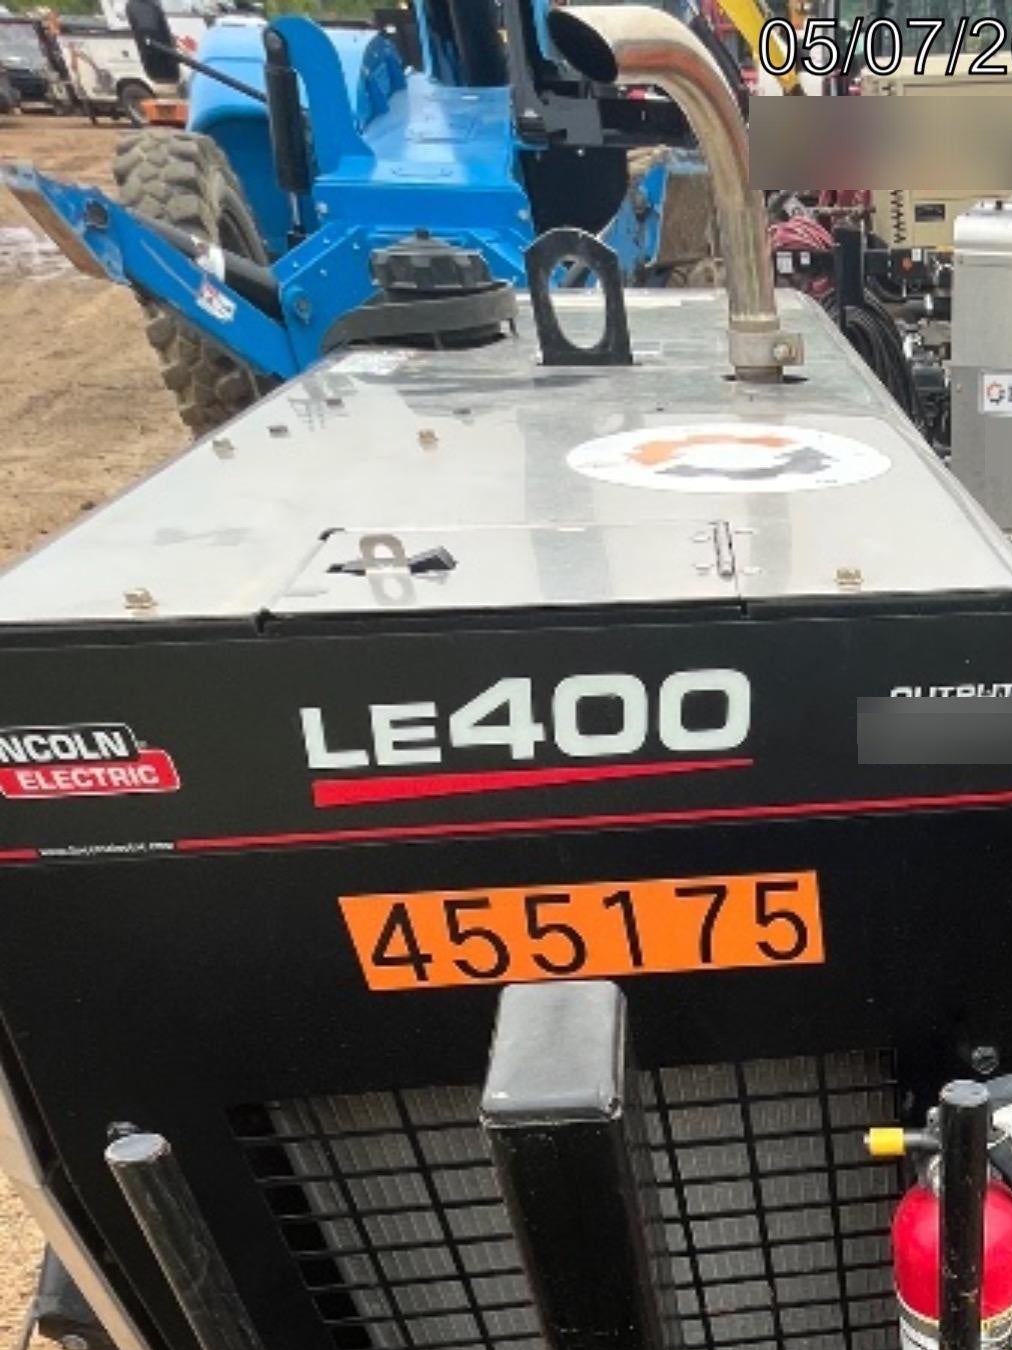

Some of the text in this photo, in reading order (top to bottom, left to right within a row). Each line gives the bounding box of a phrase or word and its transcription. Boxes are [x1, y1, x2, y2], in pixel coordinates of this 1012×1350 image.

[300, 668, 751, 769] LE400
[16, 765, 159, 790] ELECTRIC
[370, 881, 808, 982] 455175
